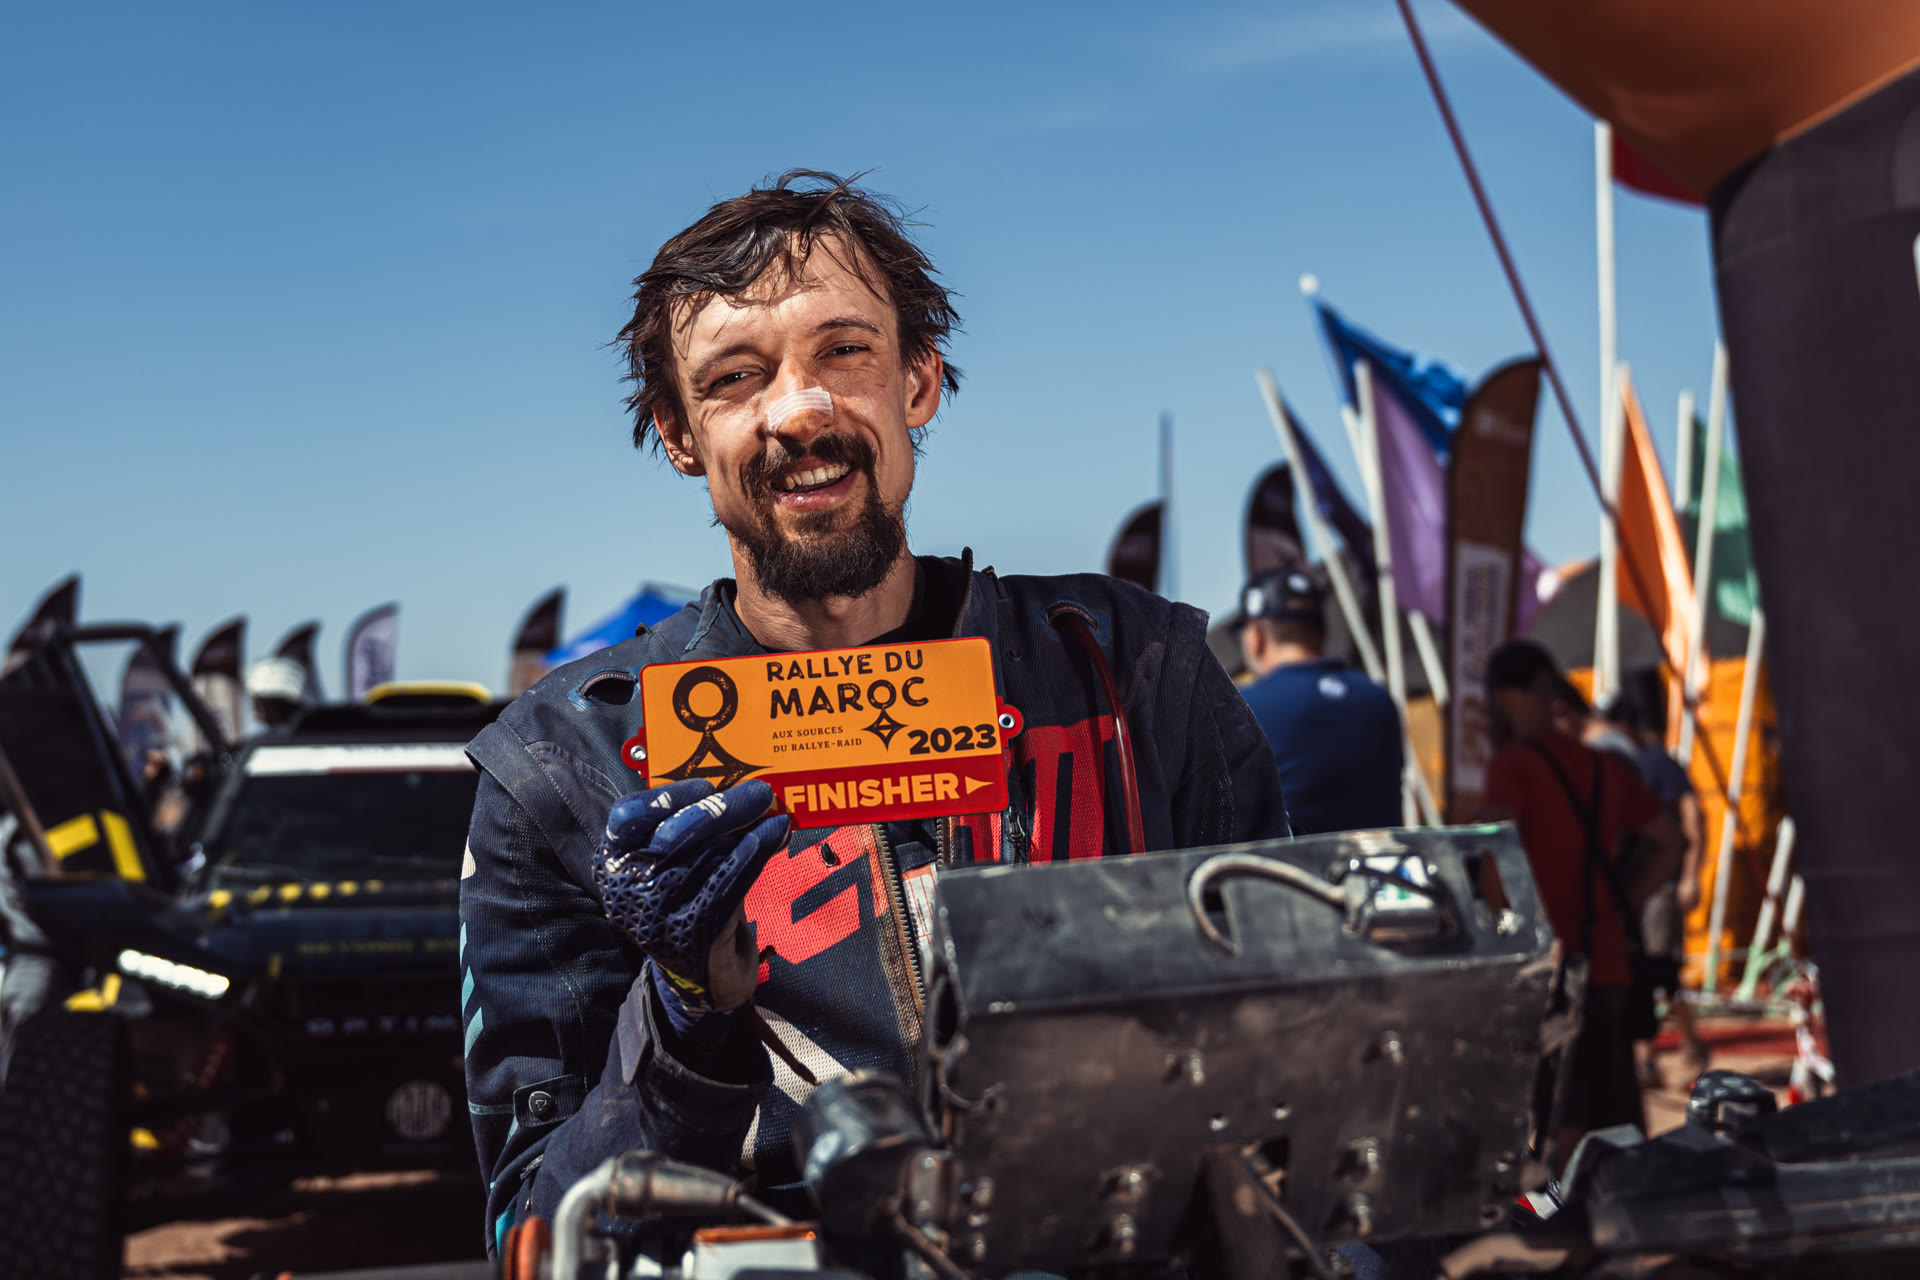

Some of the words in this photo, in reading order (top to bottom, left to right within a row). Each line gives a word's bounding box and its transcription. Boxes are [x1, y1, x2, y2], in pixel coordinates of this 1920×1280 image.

[766, 653, 873, 682] RALLYE
[884, 649, 923, 673] DU
[770, 676, 929, 719] MAROC
[772, 729, 793, 740] AUX
[796, 725, 844, 738] SOURCES
[772, 744, 788, 753] DU
[790, 737, 863, 752] RALLYE-RAID
[907, 723, 997, 756] 2023
[783, 772, 960, 814] FINISHER
